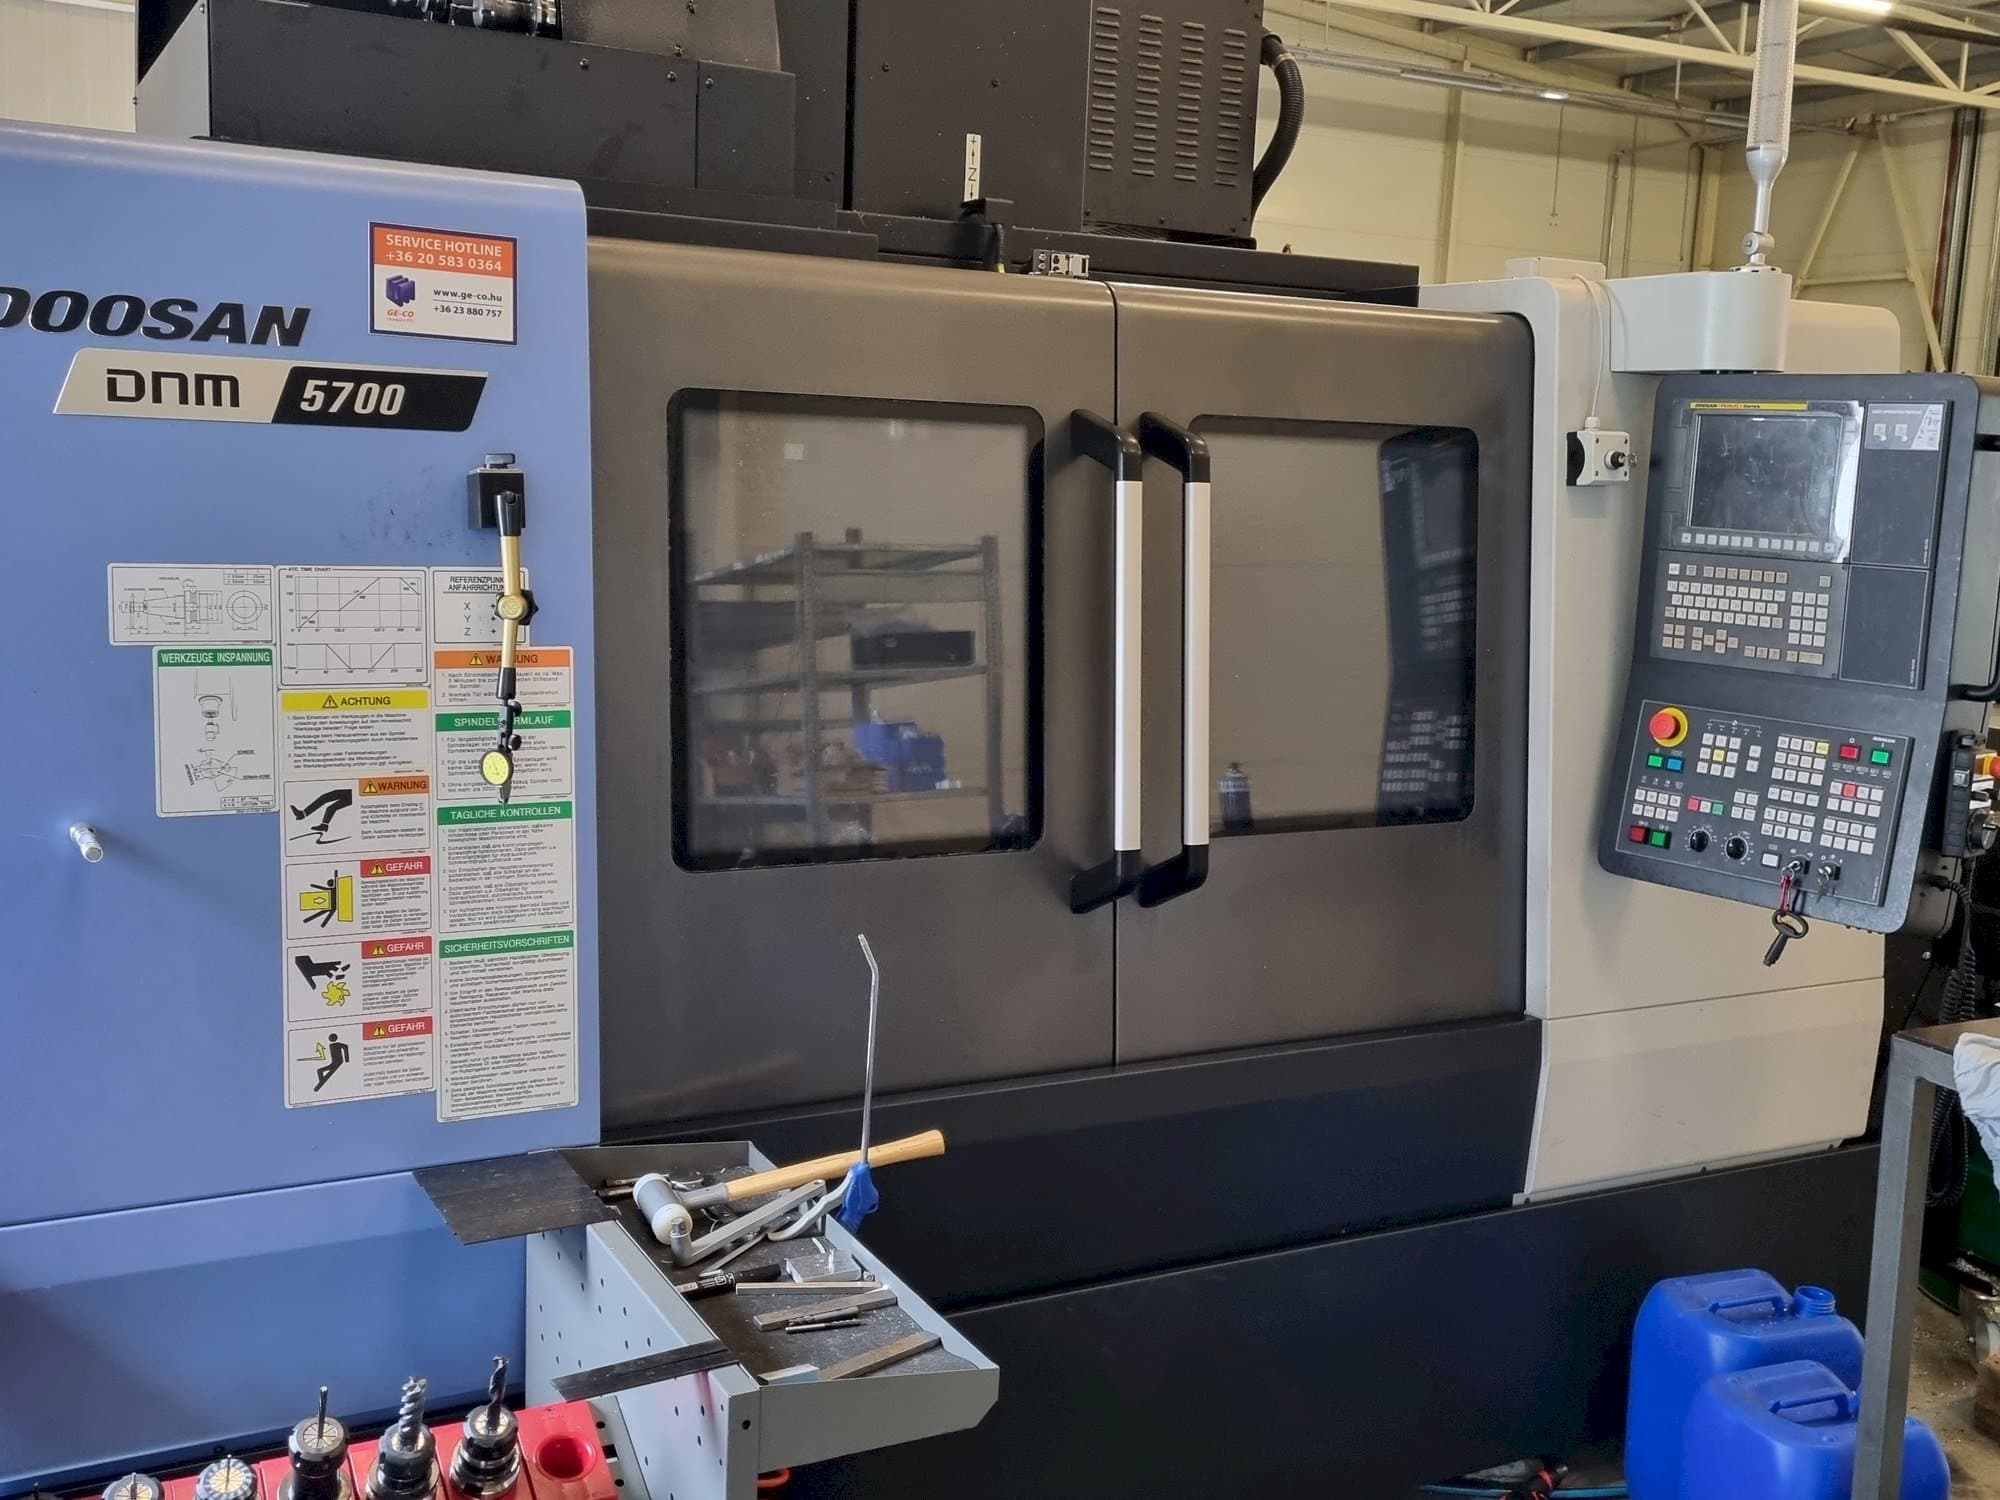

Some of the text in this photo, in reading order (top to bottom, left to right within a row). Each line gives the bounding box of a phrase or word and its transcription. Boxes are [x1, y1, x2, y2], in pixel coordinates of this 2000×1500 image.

[386, 234, 502, 257] SERVICE HOTLINE
[386, 250, 502, 272] +36 20 583 0364
[433, 288, 503, 302] www.ge-co.hu
[387, 308, 414, 318] GE-CO
[433, 304, 503, 318] +36 23 880 757
[300, 379, 405, 416] 5700
[450, 576, 504, 584] REFERENZPUNK
[448, 583, 505, 592] ANFAHRRICHTUN
[161, 651, 270, 664] WERKZEUGE INSPANNUNG
[486, 654, 538, 664] WAUNG
[340, 696, 391, 706] ACHTUNG
[454, 715, 554, 727] SPINDELRMLAUF
[377, 780, 427, 791] WARNUNG
[500, 806, 561, 818] KONTROLLEN
[385, 861, 423, 873] GEFAHR
[386, 941, 425, 953] GEFAHR
[444, 935, 570, 954] SICHERHEITSVORSCHRIFTEN
[387, 1021, 425, 1033] GEFAHR
